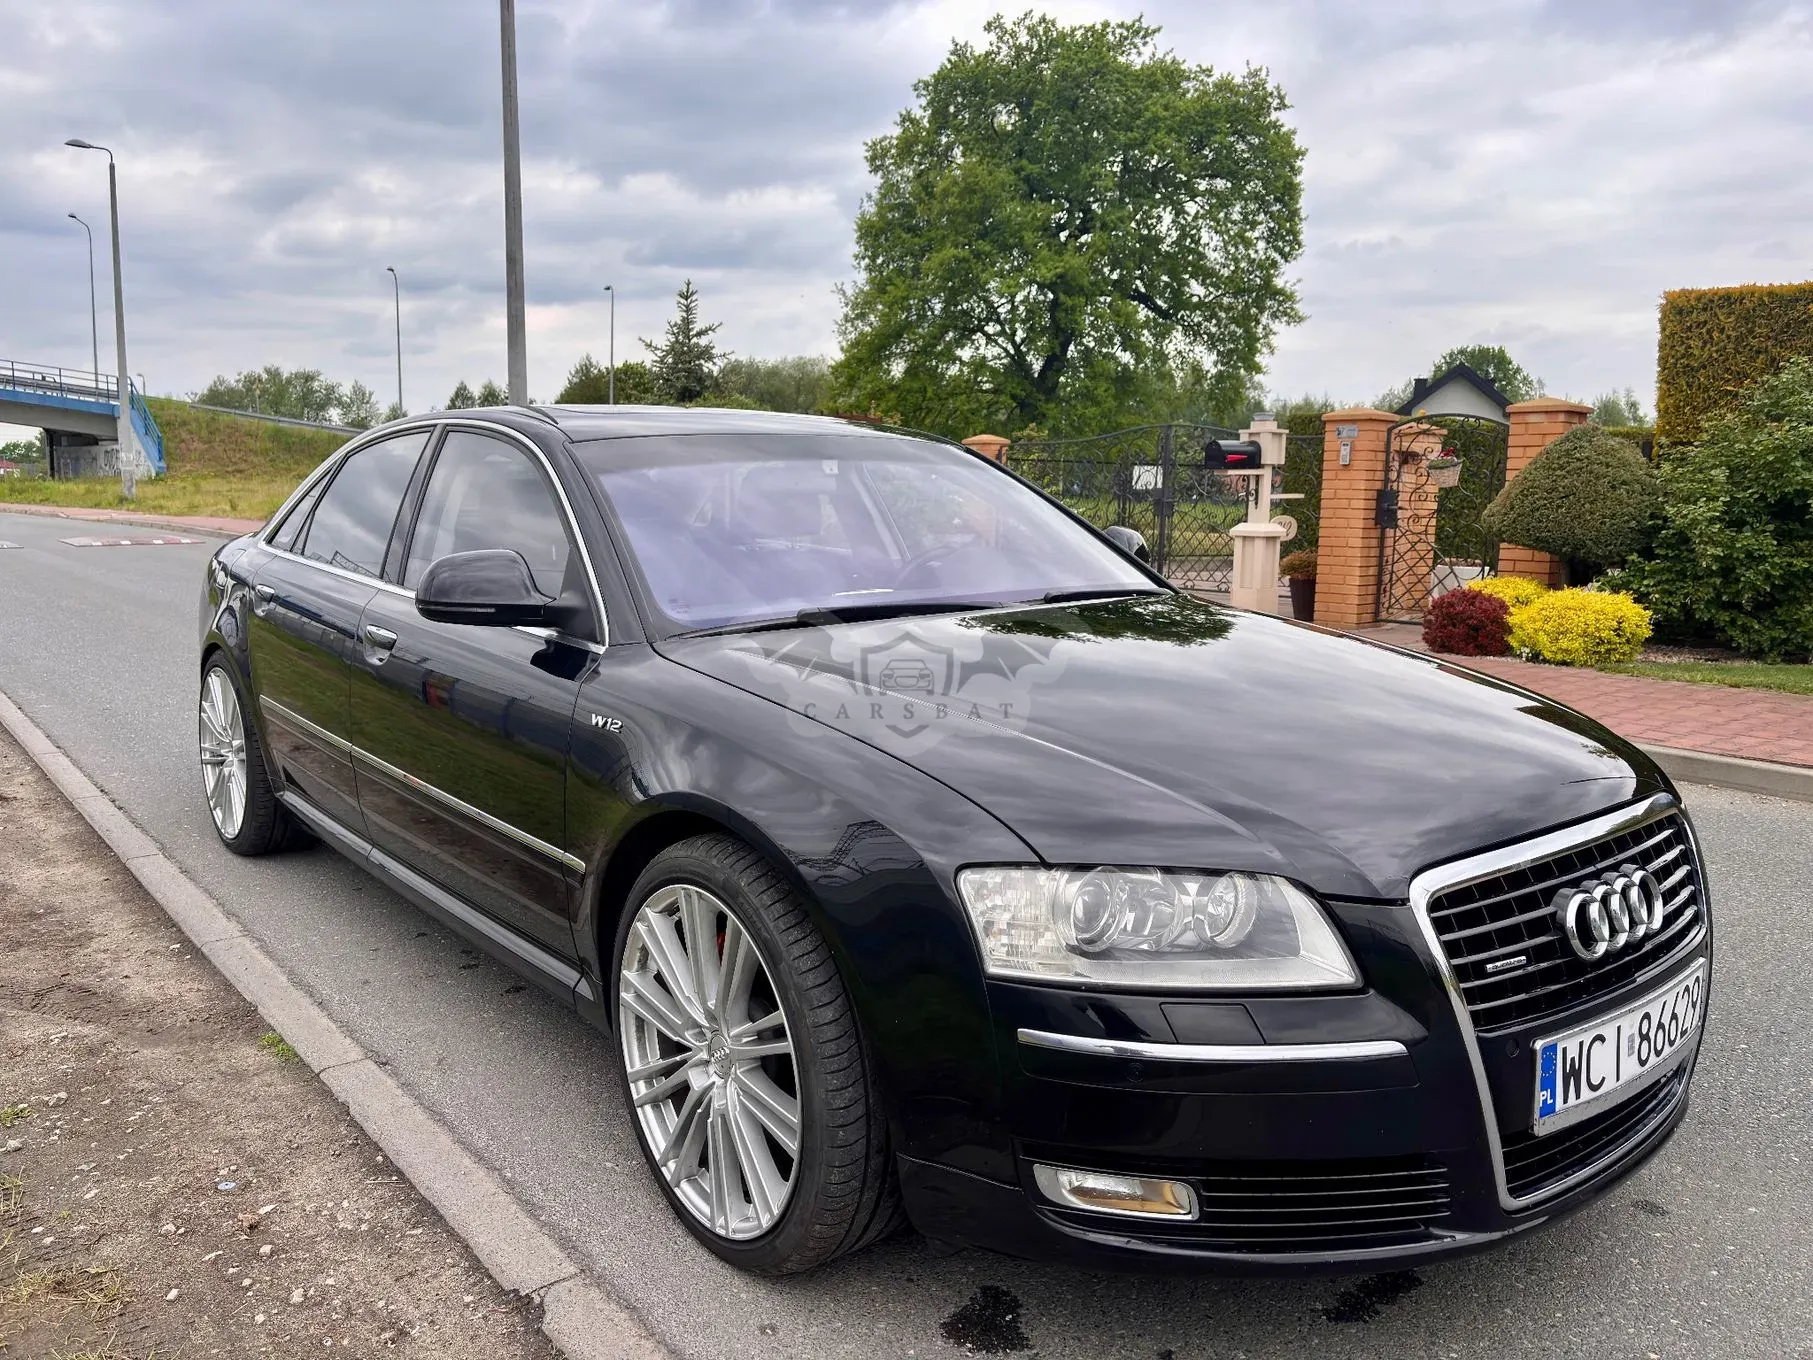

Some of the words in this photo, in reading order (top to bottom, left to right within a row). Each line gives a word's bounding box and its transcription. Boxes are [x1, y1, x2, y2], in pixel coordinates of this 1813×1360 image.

[591, 713, 622, 733] W12
[1561, 1024, 1622, 1106] WCI
[1637, 975, 1701, 1068] 86629
[1540, 1088, 1554, 1107] PL
